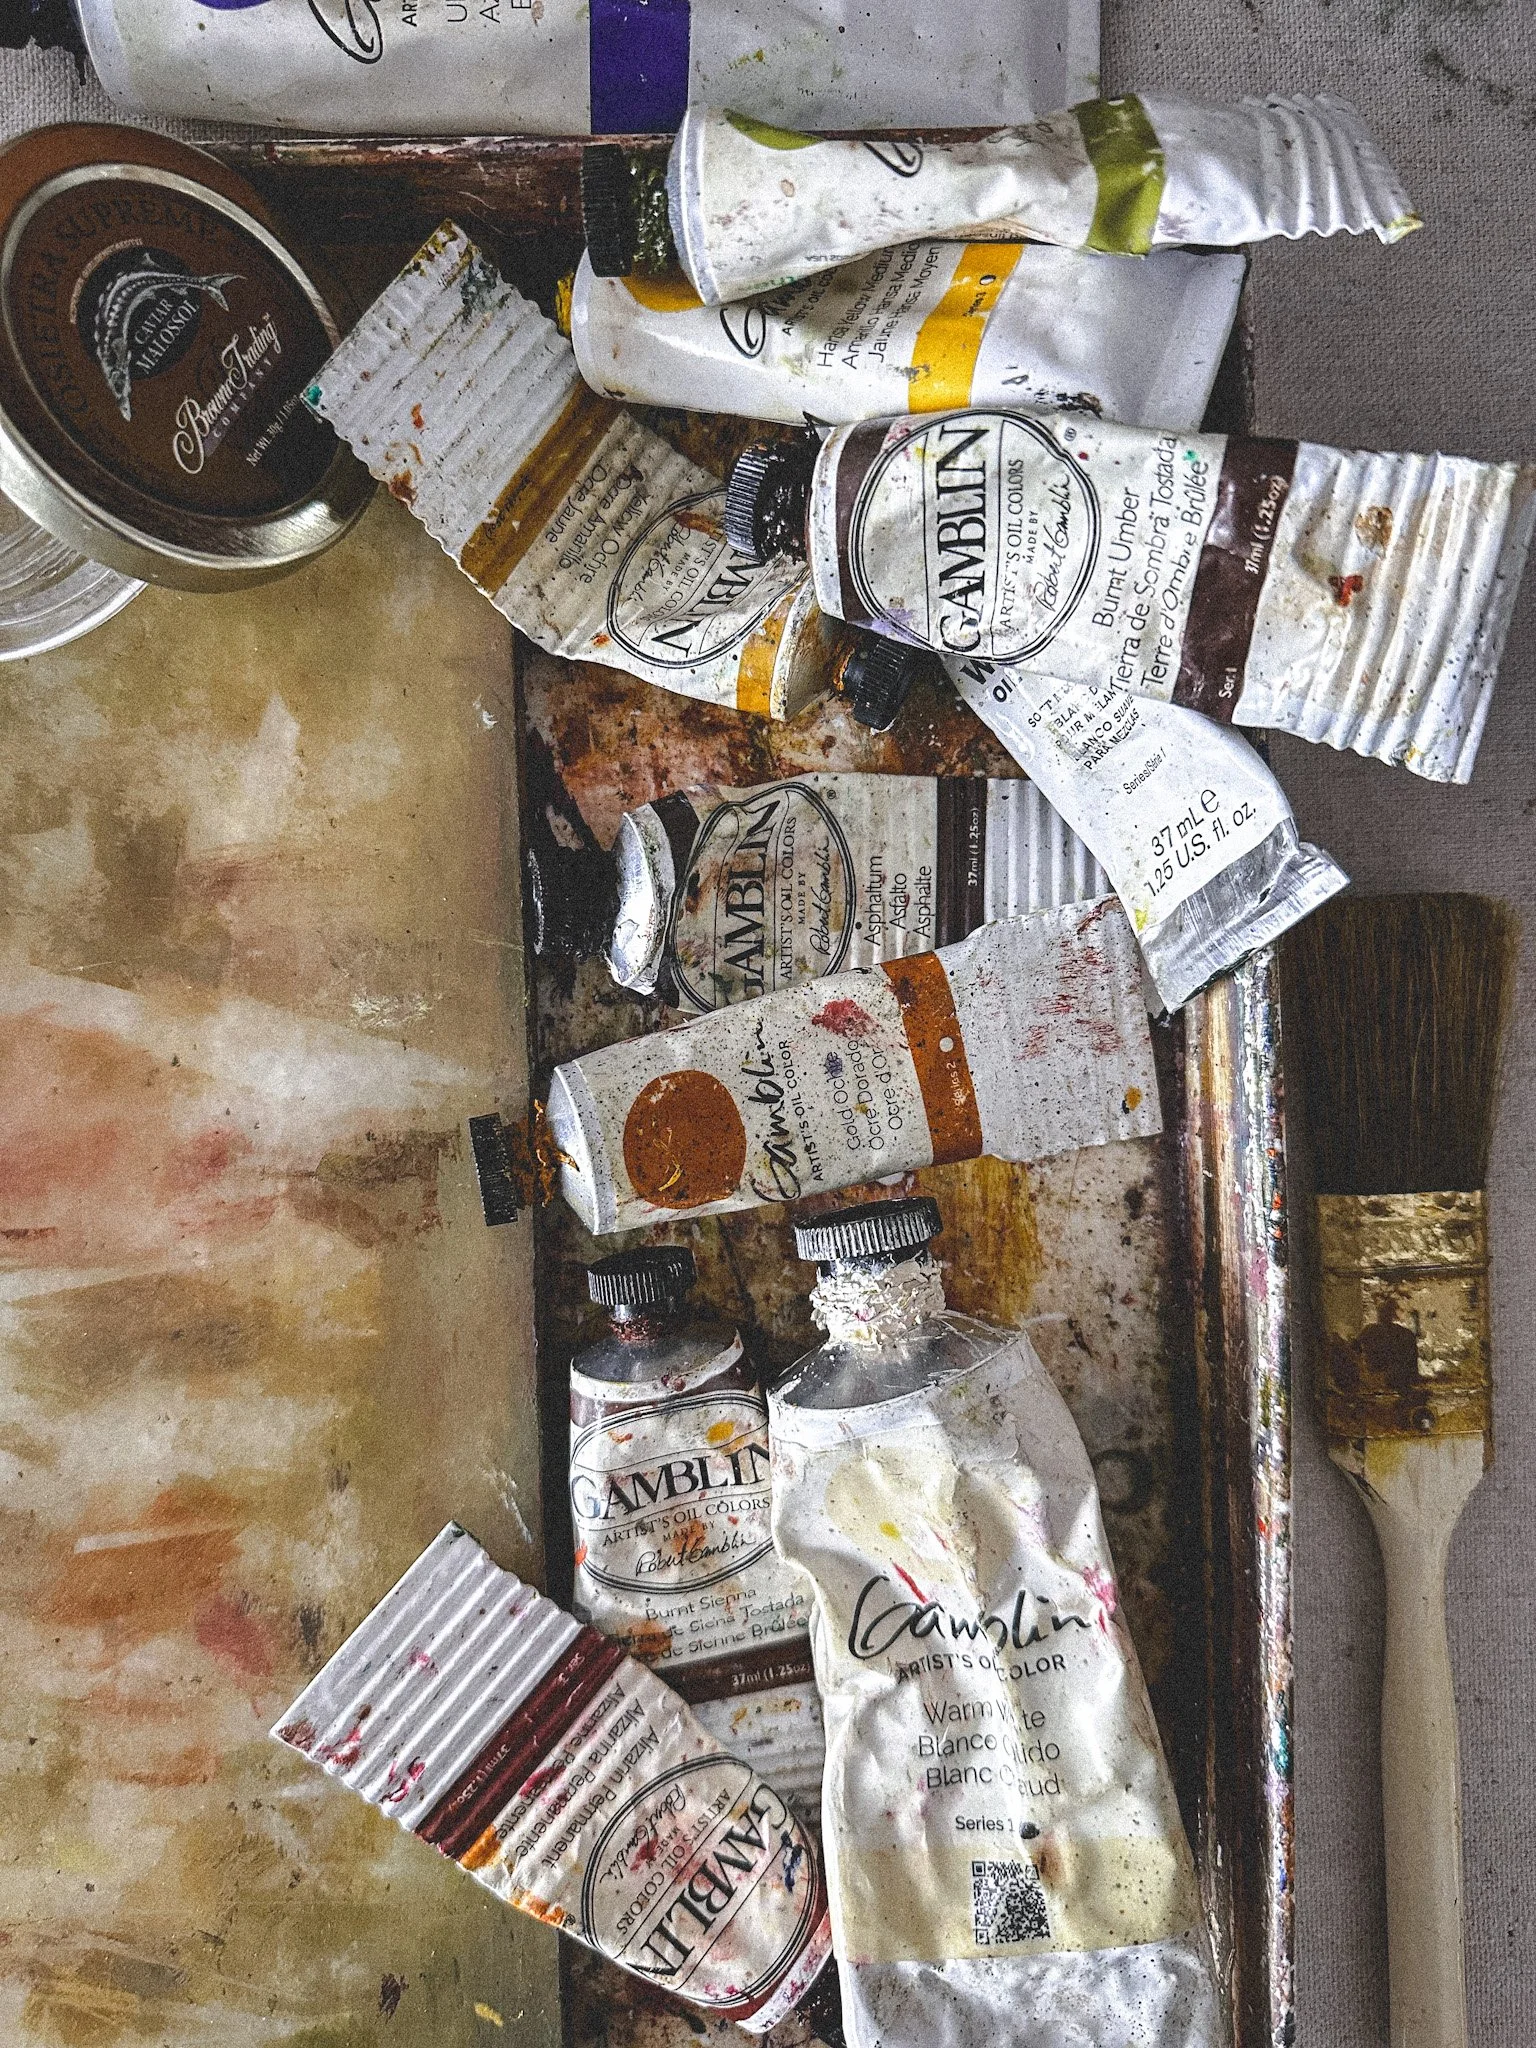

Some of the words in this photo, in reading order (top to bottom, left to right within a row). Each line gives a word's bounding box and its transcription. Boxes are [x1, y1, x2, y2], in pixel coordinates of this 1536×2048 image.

[870, 282, 901, 315] Hansa
[890, 289, 920, 320] Hansa
[909, 243, 942, 290] Moyen
[134, 298, 174, 345] CAVIAR
[136, 301, 200, 374] MALOSSOL
[815, 324, 848, 370] Hansa
[841, 293, 870, 325] Yellow
[173, 379, 235, 473] Brown
[221, 319, 281, 390] Trading
[214, 358, 273, 438] COMPANY
[246, 447, 262, 466] Net
[1151, 436, 1177, 503] Tostada
[572, 463, 610, 505] Ocre
[598, 472, 633, 512] Ocre
[1006, 459, 1023, 513] COLORS
[544, 496, 580, 545] Jaune
[612, 491, 651, 538] Yellow
[1005, 517, 1021, 546] OIL
[1028, 510, 1038, 523] BY
[1047, 474, 1068, 545] Gamblin
[556, 510, 604, 572] Amarillo
[578, 536, 621, 585] Ochre
[938, 424, 989, 652] GAMBLIN
[1023, 527, 1037, 563] MADE
[1092, 566, 1126, 628] Burnt
[1109, 486, 1143, 562] Umber
[1134, 514, 1170, 597] Sombra
[1243, 542, 1264, 574] 37ml
[661, 579, 672, 591] BY
[671, 552, 690, 577] MADE
[677, 565, 700, 593] OIL
[1141, 633, 1173, 685] Terre
[1157, 531, 1198, 629] d'Ombre
[1179, 459, 1208, 525] Brûlée
[997, 552, 1019, 629] ARTIST'S
[1122, 600, 1149, 631] de
[1109, 636, 1141, 692] Tierra
[1111, 693, 1135, 722] SUAVE
[1083, 743, 1111, 770] PARA
[1109, 707, 1140, 745] MEZCLAS
[781, 817, 796, 878] COLORS
[969, 807, 979, 853] (1.25oz)
[1143, 857, 1176, 896] 1.25
[1172, 831, 1211, 868] U.S.
[1209, 817, 1229, 841] fl.
[1229, 800, 1256, 826] oz.
[1148, 825, 1173, 856] 37
[1174, 807, 1204, 838] mL
[797, 872, 806, 885] BY
[811, 835, 830, 903] Gamblin
[967, 857, 977, 885] 37ml
[782, 882, 791, 910] OIL
[797, 890, 806, 924] MADE
[863, 855, 886, 945] Asphaltum
[888, 872, 907, 928] Asfalto
[913, 865, 934, 937] Asphalte
[780, 913, 796, 979] ARTIST'S
[809, 901, 829, 954] Robert
[779, 1039, 796, 1087] COLOR
[846, 1041, 872, 1104] Dorado
[871, 1048, 891, 1081] d'Or
[741, 1020, 801, 1200] Gamblin
[791, 1092, 804, 1114] OIL
[884, 1089, 901, 1128] Ocre
[798, 1120, 823, 1180] ARTIST'S
[836, 1108, 860, 1148] Gold
[865, 1109, 884, 1148] Ocre
[572, 1442, 771, 1519] GAMBLIN
[602, 1511, 670, 1546] ARTIST'S
[674, 1504, 696, 1523] OIL
[705, 1497, 770, 1515] COLORS
[646, 1603, 695, 1620] Burnt
[699, 1588, 756, 1610] Sienna
[690, 1615, 735, 1633] Siena
[740, 1594, 804, 1618] Tostada
[731, 1667, 760, 1685] 37ml
[896, 1653, 972, 1684] ARTIST'S
[588, 1698, 644, 1766] Alizarina
[924, 1700, 992, 1725] Warm
[483, 1742, 511, 1774] 37ml
[609, 1725, 659, 1787] Alizarin
[918, 1733, 997, 1757] Blanco
[927, 1766, 992, 1789] Blanc
[513, 1764, 596, 1860] Permanente
[541, 1784, 616, 1869] Permanent
[682, 1788, 730, 1846] ARTIST'S
[956, 1816, 1003, 1831] Series
[653, 1825, 680, 1853] MADE
[659, 1843, 686, 1874] OIL
[614, 1869, 666, 1933] COLORS
[626, 1784, 785, 1984] GAMBLIN
